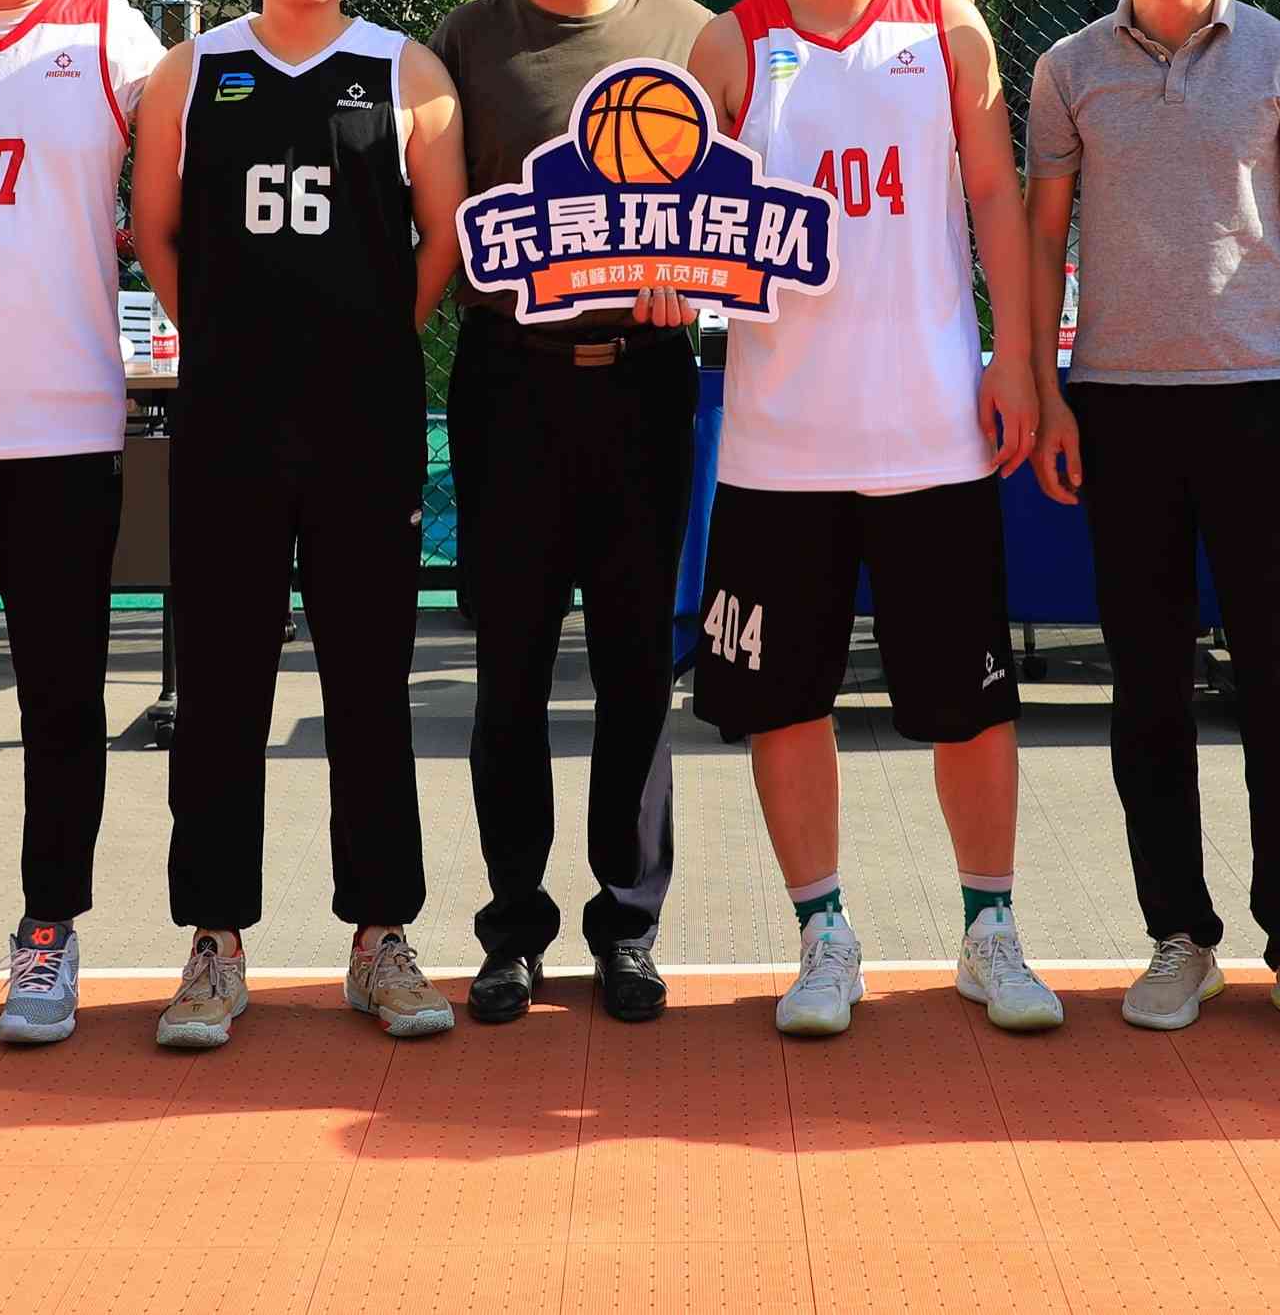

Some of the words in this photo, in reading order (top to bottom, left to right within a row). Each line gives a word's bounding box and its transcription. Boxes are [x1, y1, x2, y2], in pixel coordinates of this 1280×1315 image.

[336, 99, 374, 110] RIGORER
[890, 67, 925, 75] RIGORER
[245, 164, 331, 236] 66
[812, 146, 905, 217] 404
[475, 193, 813, 272] 东晟环保队
[570, 263, 645, 289] 巅峰对决
[704, 589, 763, 671] 404
